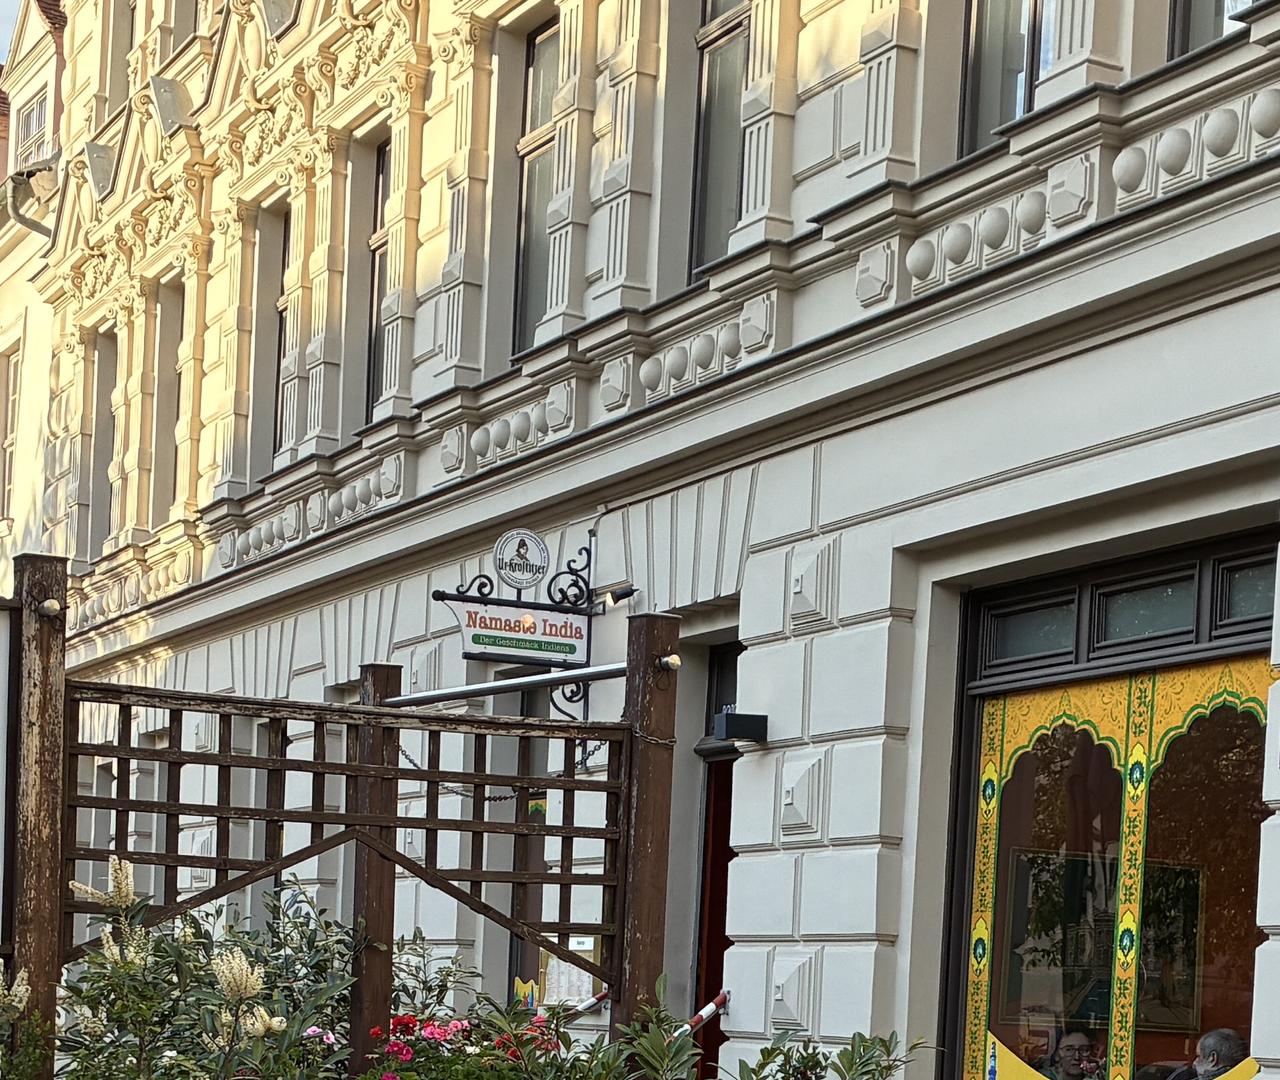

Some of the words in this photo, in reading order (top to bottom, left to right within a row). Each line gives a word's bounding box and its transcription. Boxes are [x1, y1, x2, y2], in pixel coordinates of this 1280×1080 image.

[465, 610, 537, 636] Namaste
[541, 618, 584, 640] India
[479, 635, 495, 645] Der
[496, 637, 539, 650] Geschmack
[541, 641, 570, 653] Indiens
